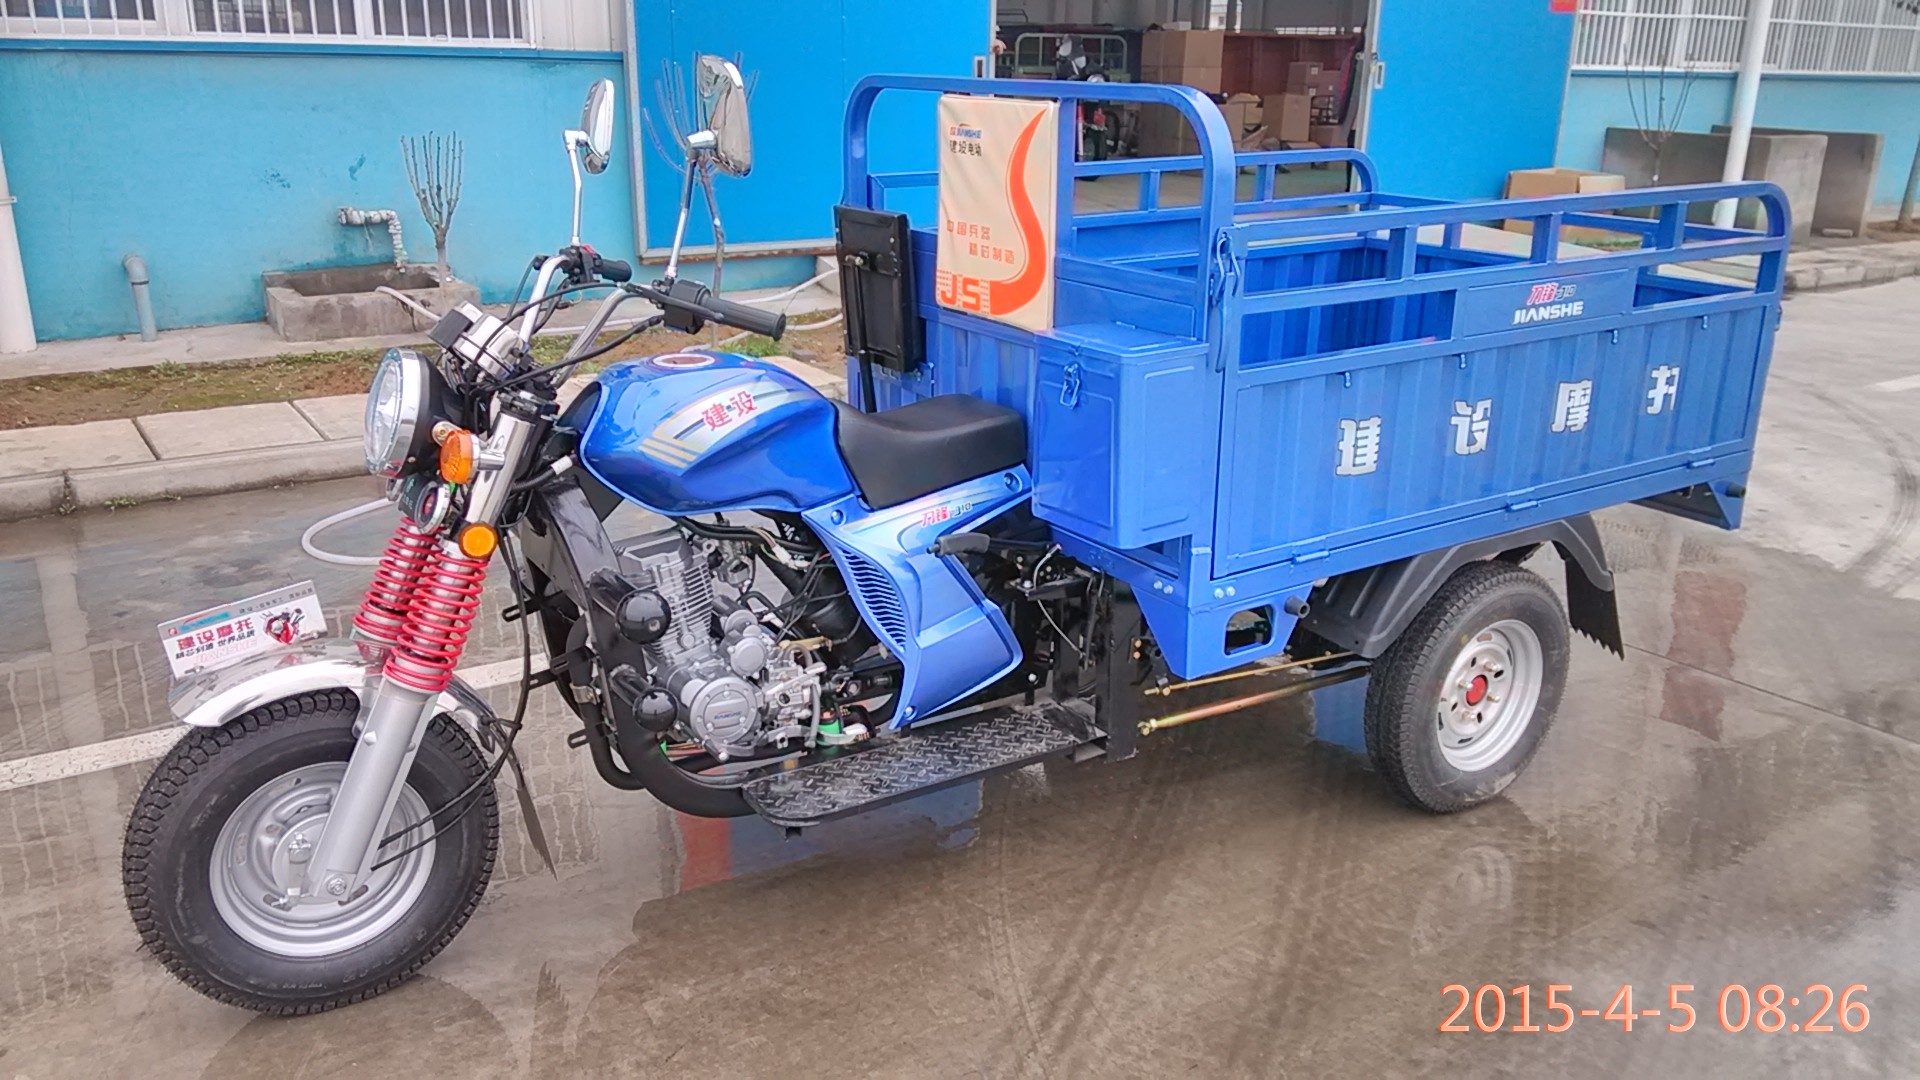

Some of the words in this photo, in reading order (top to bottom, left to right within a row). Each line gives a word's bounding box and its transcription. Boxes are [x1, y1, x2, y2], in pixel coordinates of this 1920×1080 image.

[946, 219, 991, 241] 中国兵器
[1512, 301, 1584, 325] JIANSHE
[702, 390, 758, 431] 建设
[176, 617, 254, 650] 建设摩托
